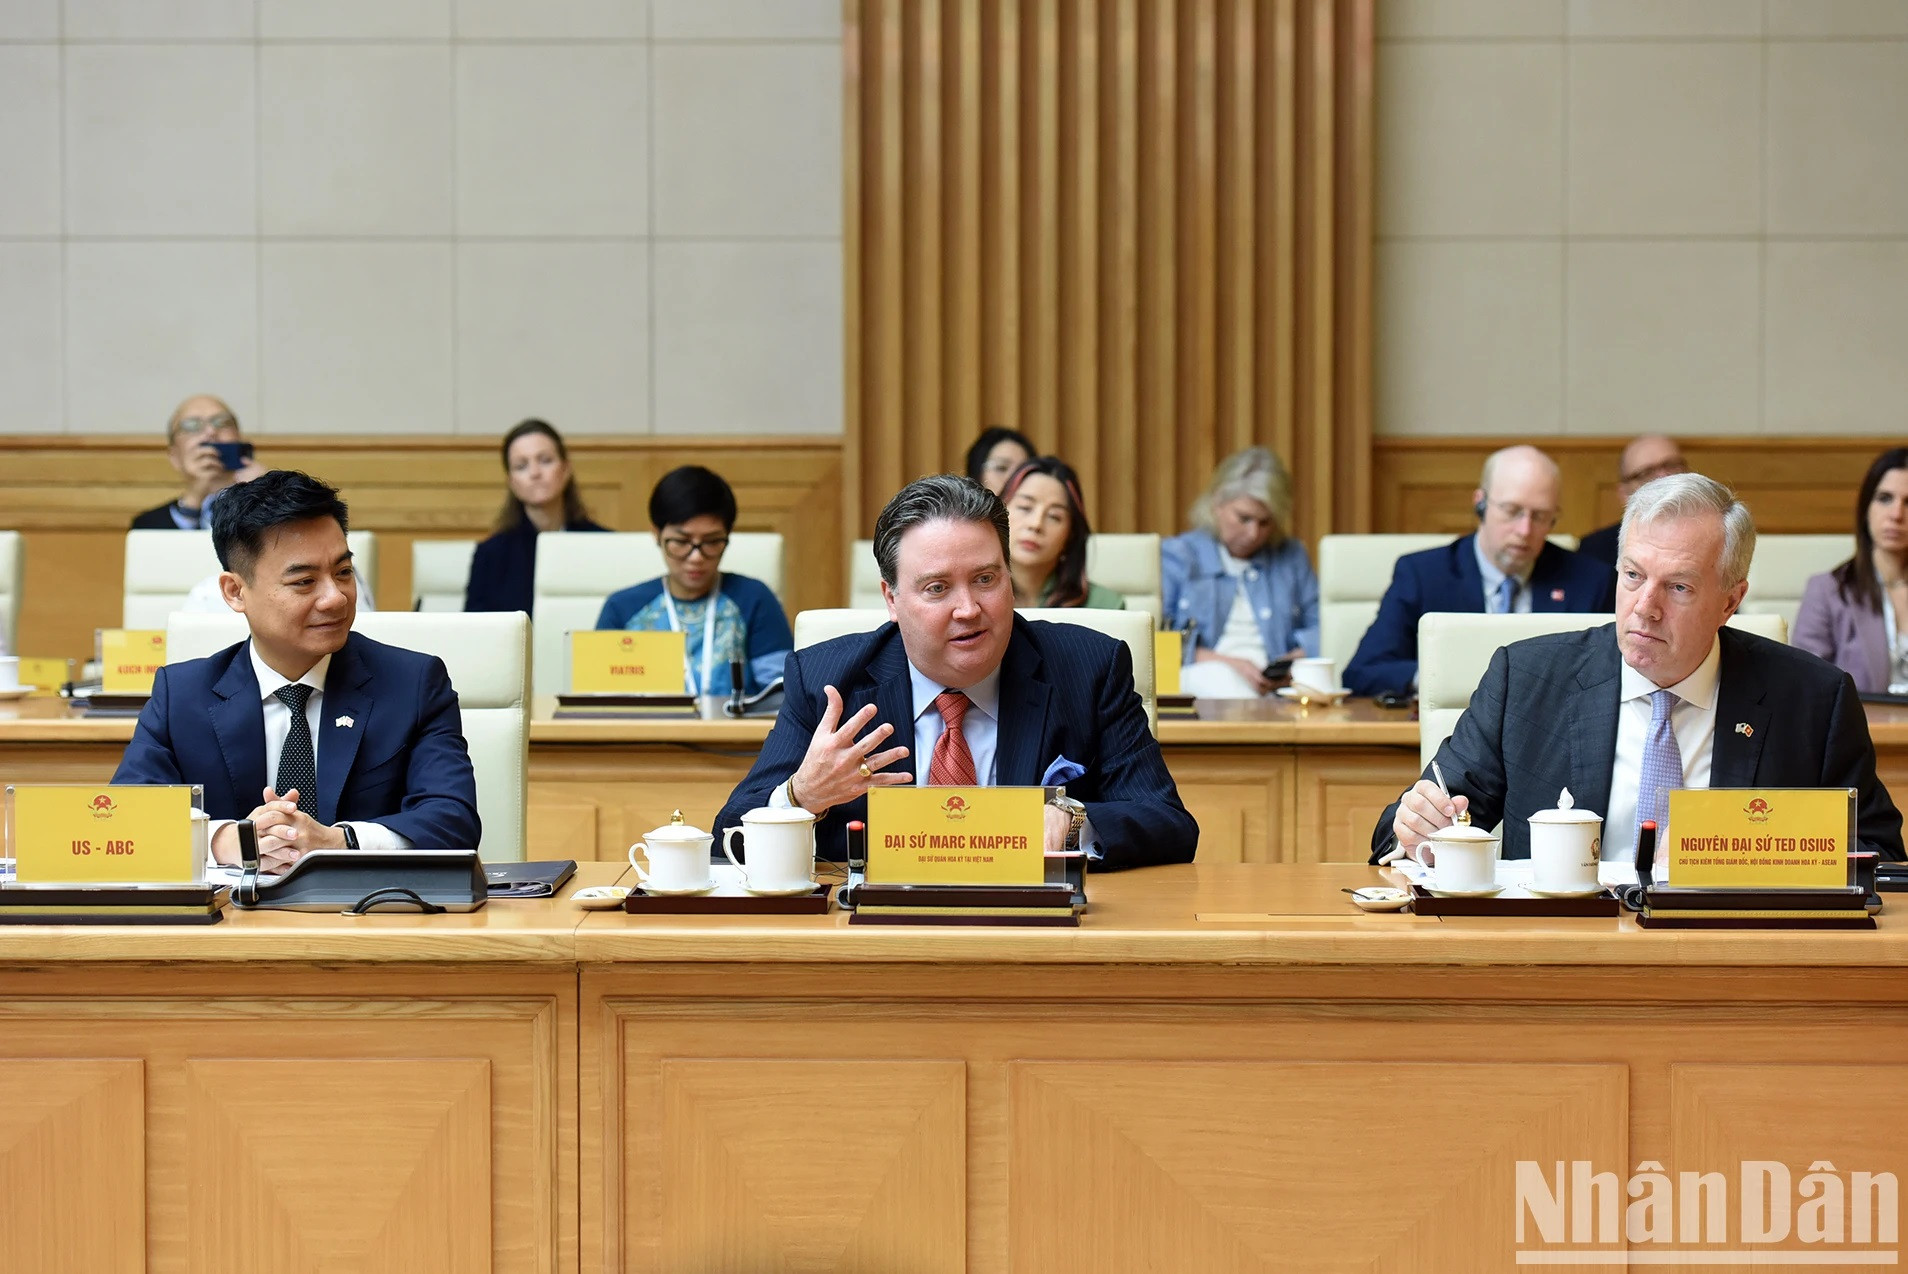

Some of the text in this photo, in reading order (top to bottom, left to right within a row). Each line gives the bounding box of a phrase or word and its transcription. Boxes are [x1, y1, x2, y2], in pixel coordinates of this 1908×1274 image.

[610, 666, 645, 675] VIATRIS
[72, 840, 91, 855] US
[105, 840, 134, 855] ABC
[884, 831, 1027, 851] ĐẠI SỨ MARC KNAPPER
[1681, 834, 1835, 854] NGUYÊN ĐẠI SỨ TED OSIUS
